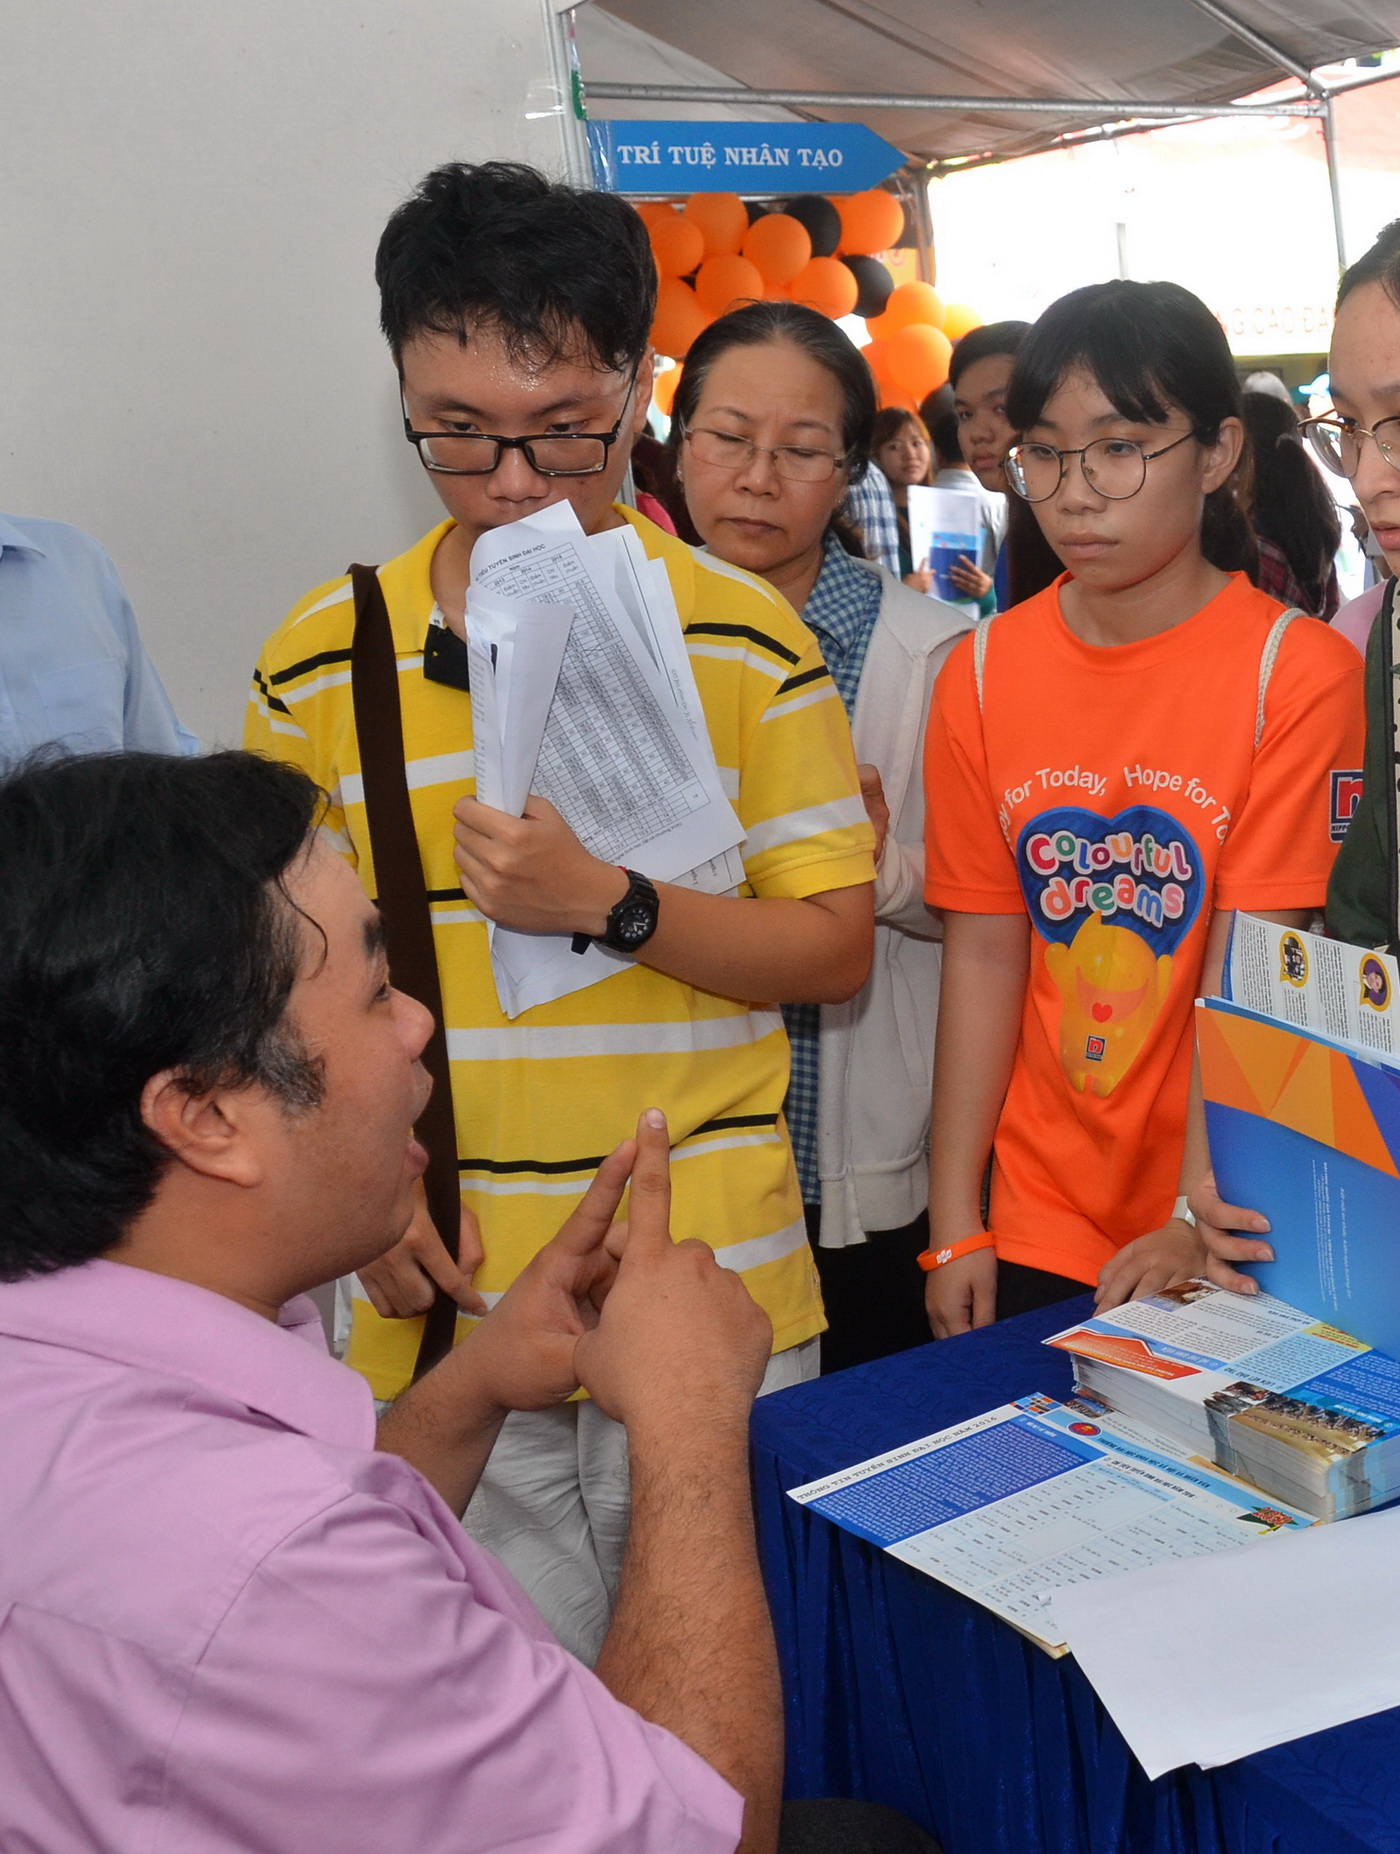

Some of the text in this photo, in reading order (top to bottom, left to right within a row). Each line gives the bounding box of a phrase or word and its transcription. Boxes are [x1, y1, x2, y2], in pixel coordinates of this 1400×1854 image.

[617, 141, 843, 171] TRÍ TUỆ NHÂN TẠO
[507, 552, 522, 561] SINH
[1004, 779, 1033, 810] for
[1035, 764, 1107, 796] Today,
[1123, 763, 1182, 792] Hope
[1183, 776, 1217, 810] for
[1211, 804, 1231, 846] To
[1026, 830, 1193, 880] Colourful
[1040, 873, 1184, 929] dreams
[830, 1473, 852, 1488] TIN
